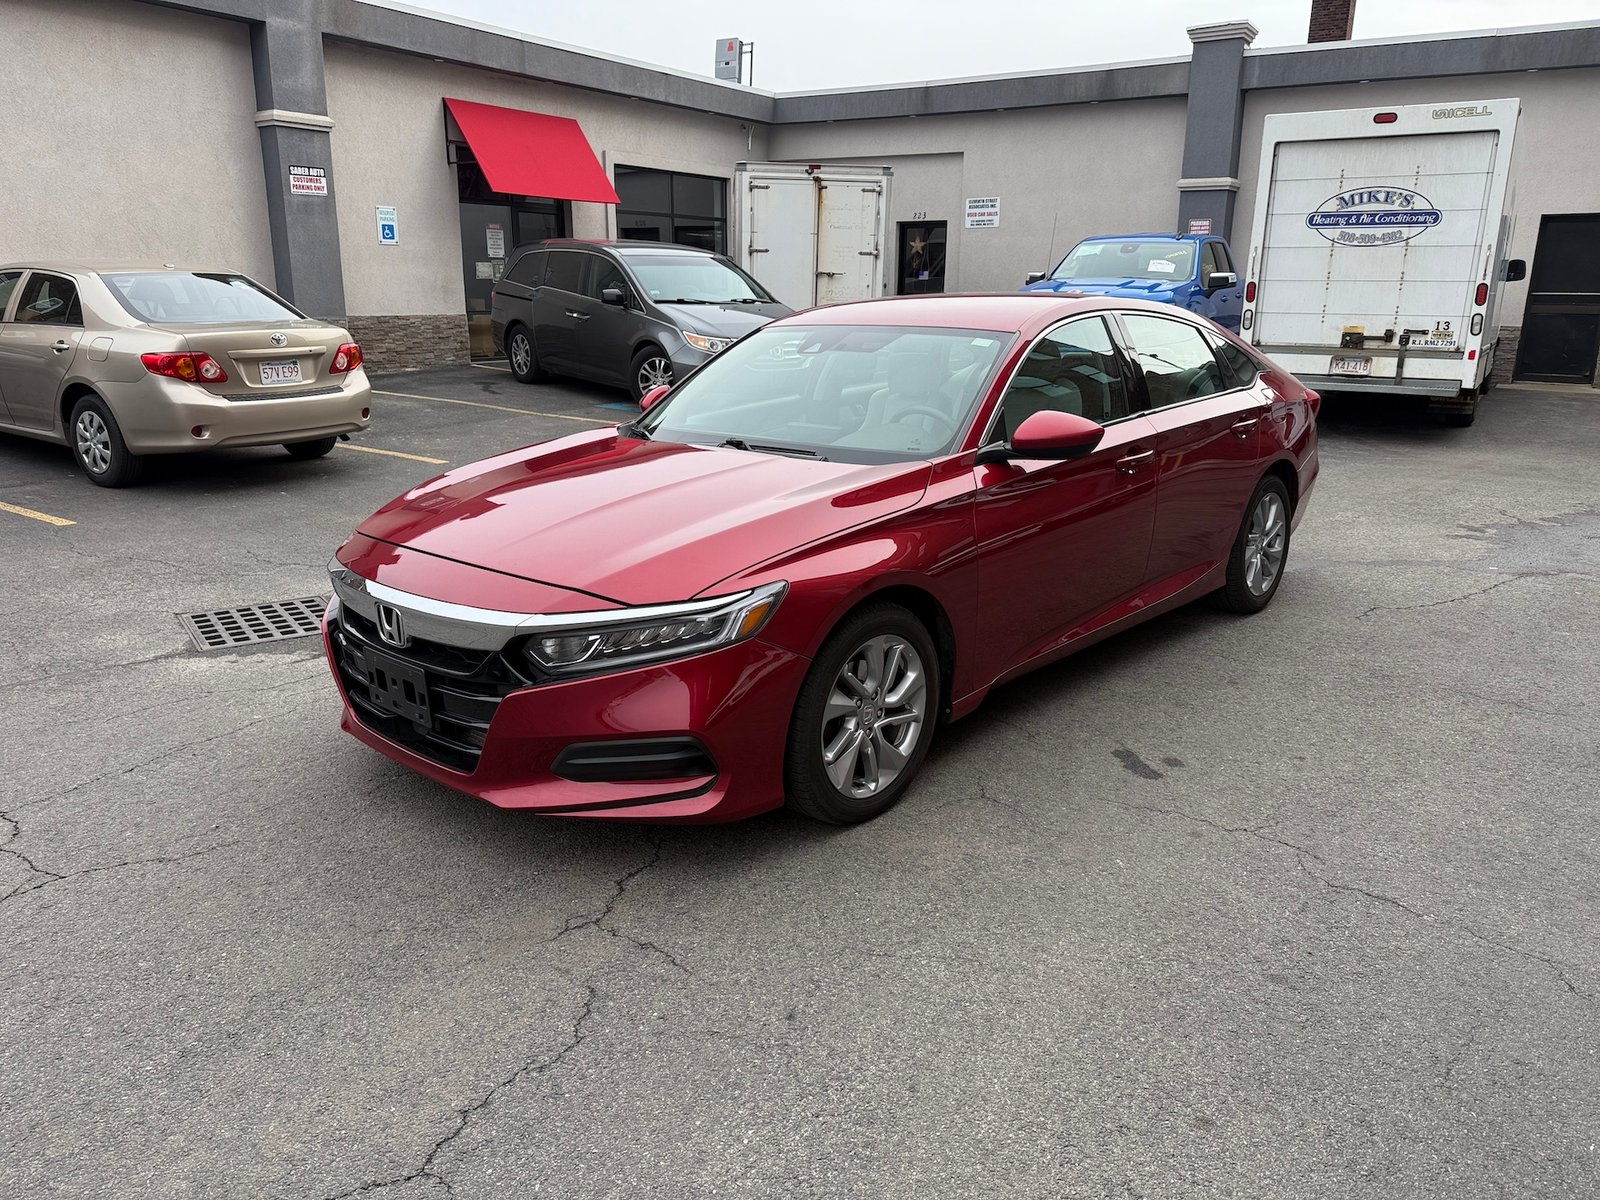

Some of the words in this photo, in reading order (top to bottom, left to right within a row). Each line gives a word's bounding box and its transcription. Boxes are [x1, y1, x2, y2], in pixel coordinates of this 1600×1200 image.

[290, 166, 309, 175] SABER
[310, 168, 325, 177] AUTO
[293, 176, 322, 184] CUSTOMERS
[1336, 190, 1415, 210] MIKE'S
[912, 211, 927, 219] 223
[1312, 214, 1346, 226] Heating
[1349, 214, 1358, 223] &
[1359, 213, 1373, 223] Air
[1375, 213, 1437, 224] Conditioning
[1435, 321, 1450, 331] 13
